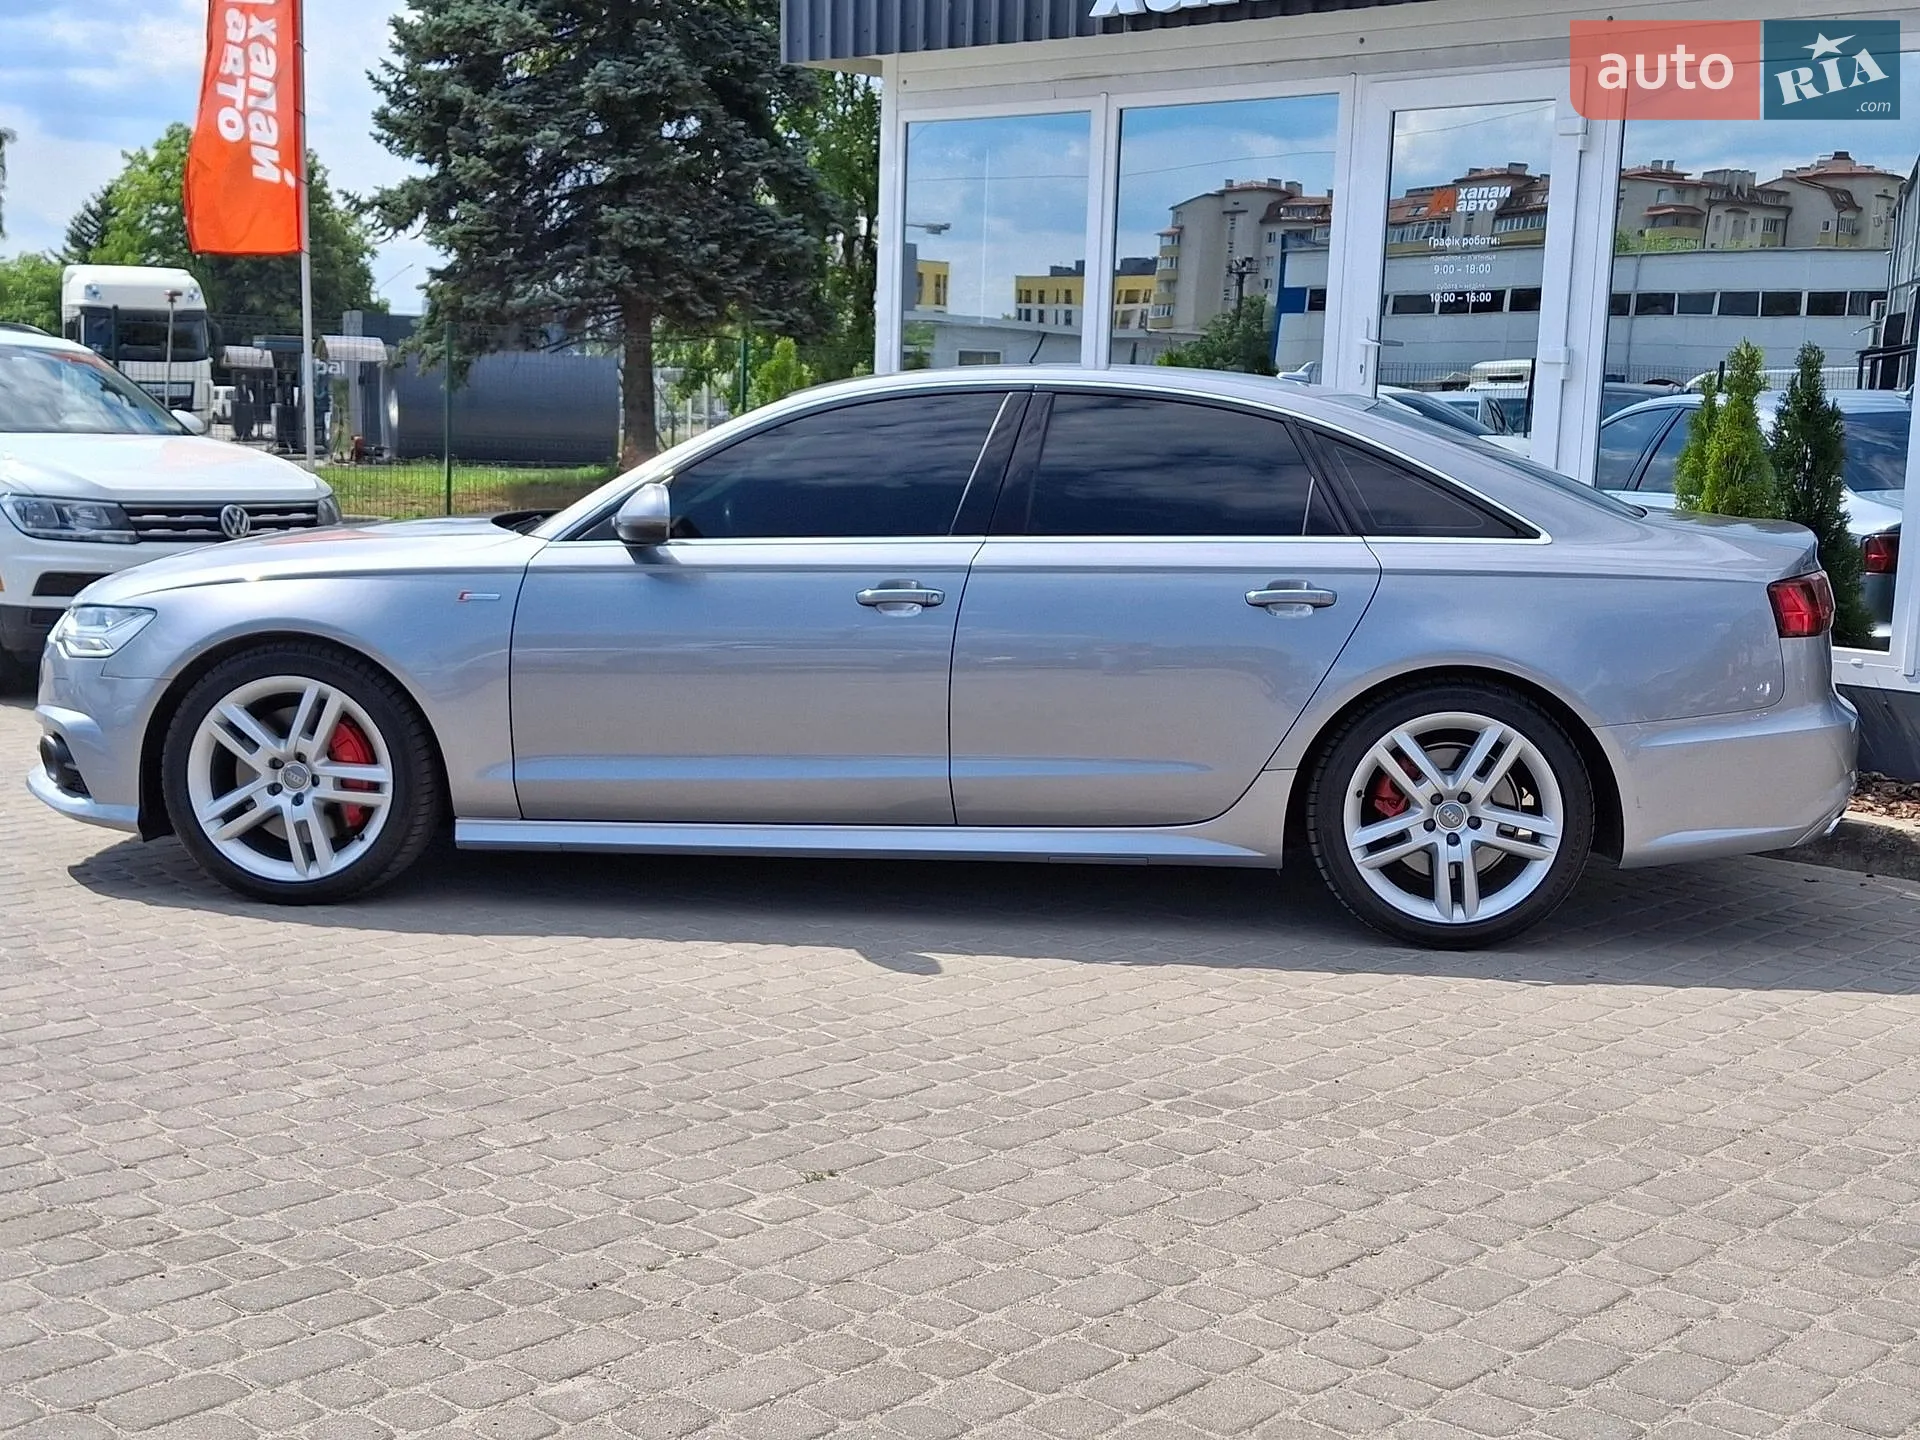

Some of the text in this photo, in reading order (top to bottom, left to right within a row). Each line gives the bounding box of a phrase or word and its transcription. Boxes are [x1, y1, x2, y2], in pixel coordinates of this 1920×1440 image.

[216, 8, 247, 143] авто
[247, 14, 296, 188] хапай
[1456, 199, 1498, 212] авто
[1428, 234, 1501, 249] Графік роботи:
[1434, 264, 1455, 274] 9:00
[1466, 263, 1491, 274] 18:00
[1430, 292, 1455, 303] 10:00
[1465, 292, 1492, 303] 16:00
